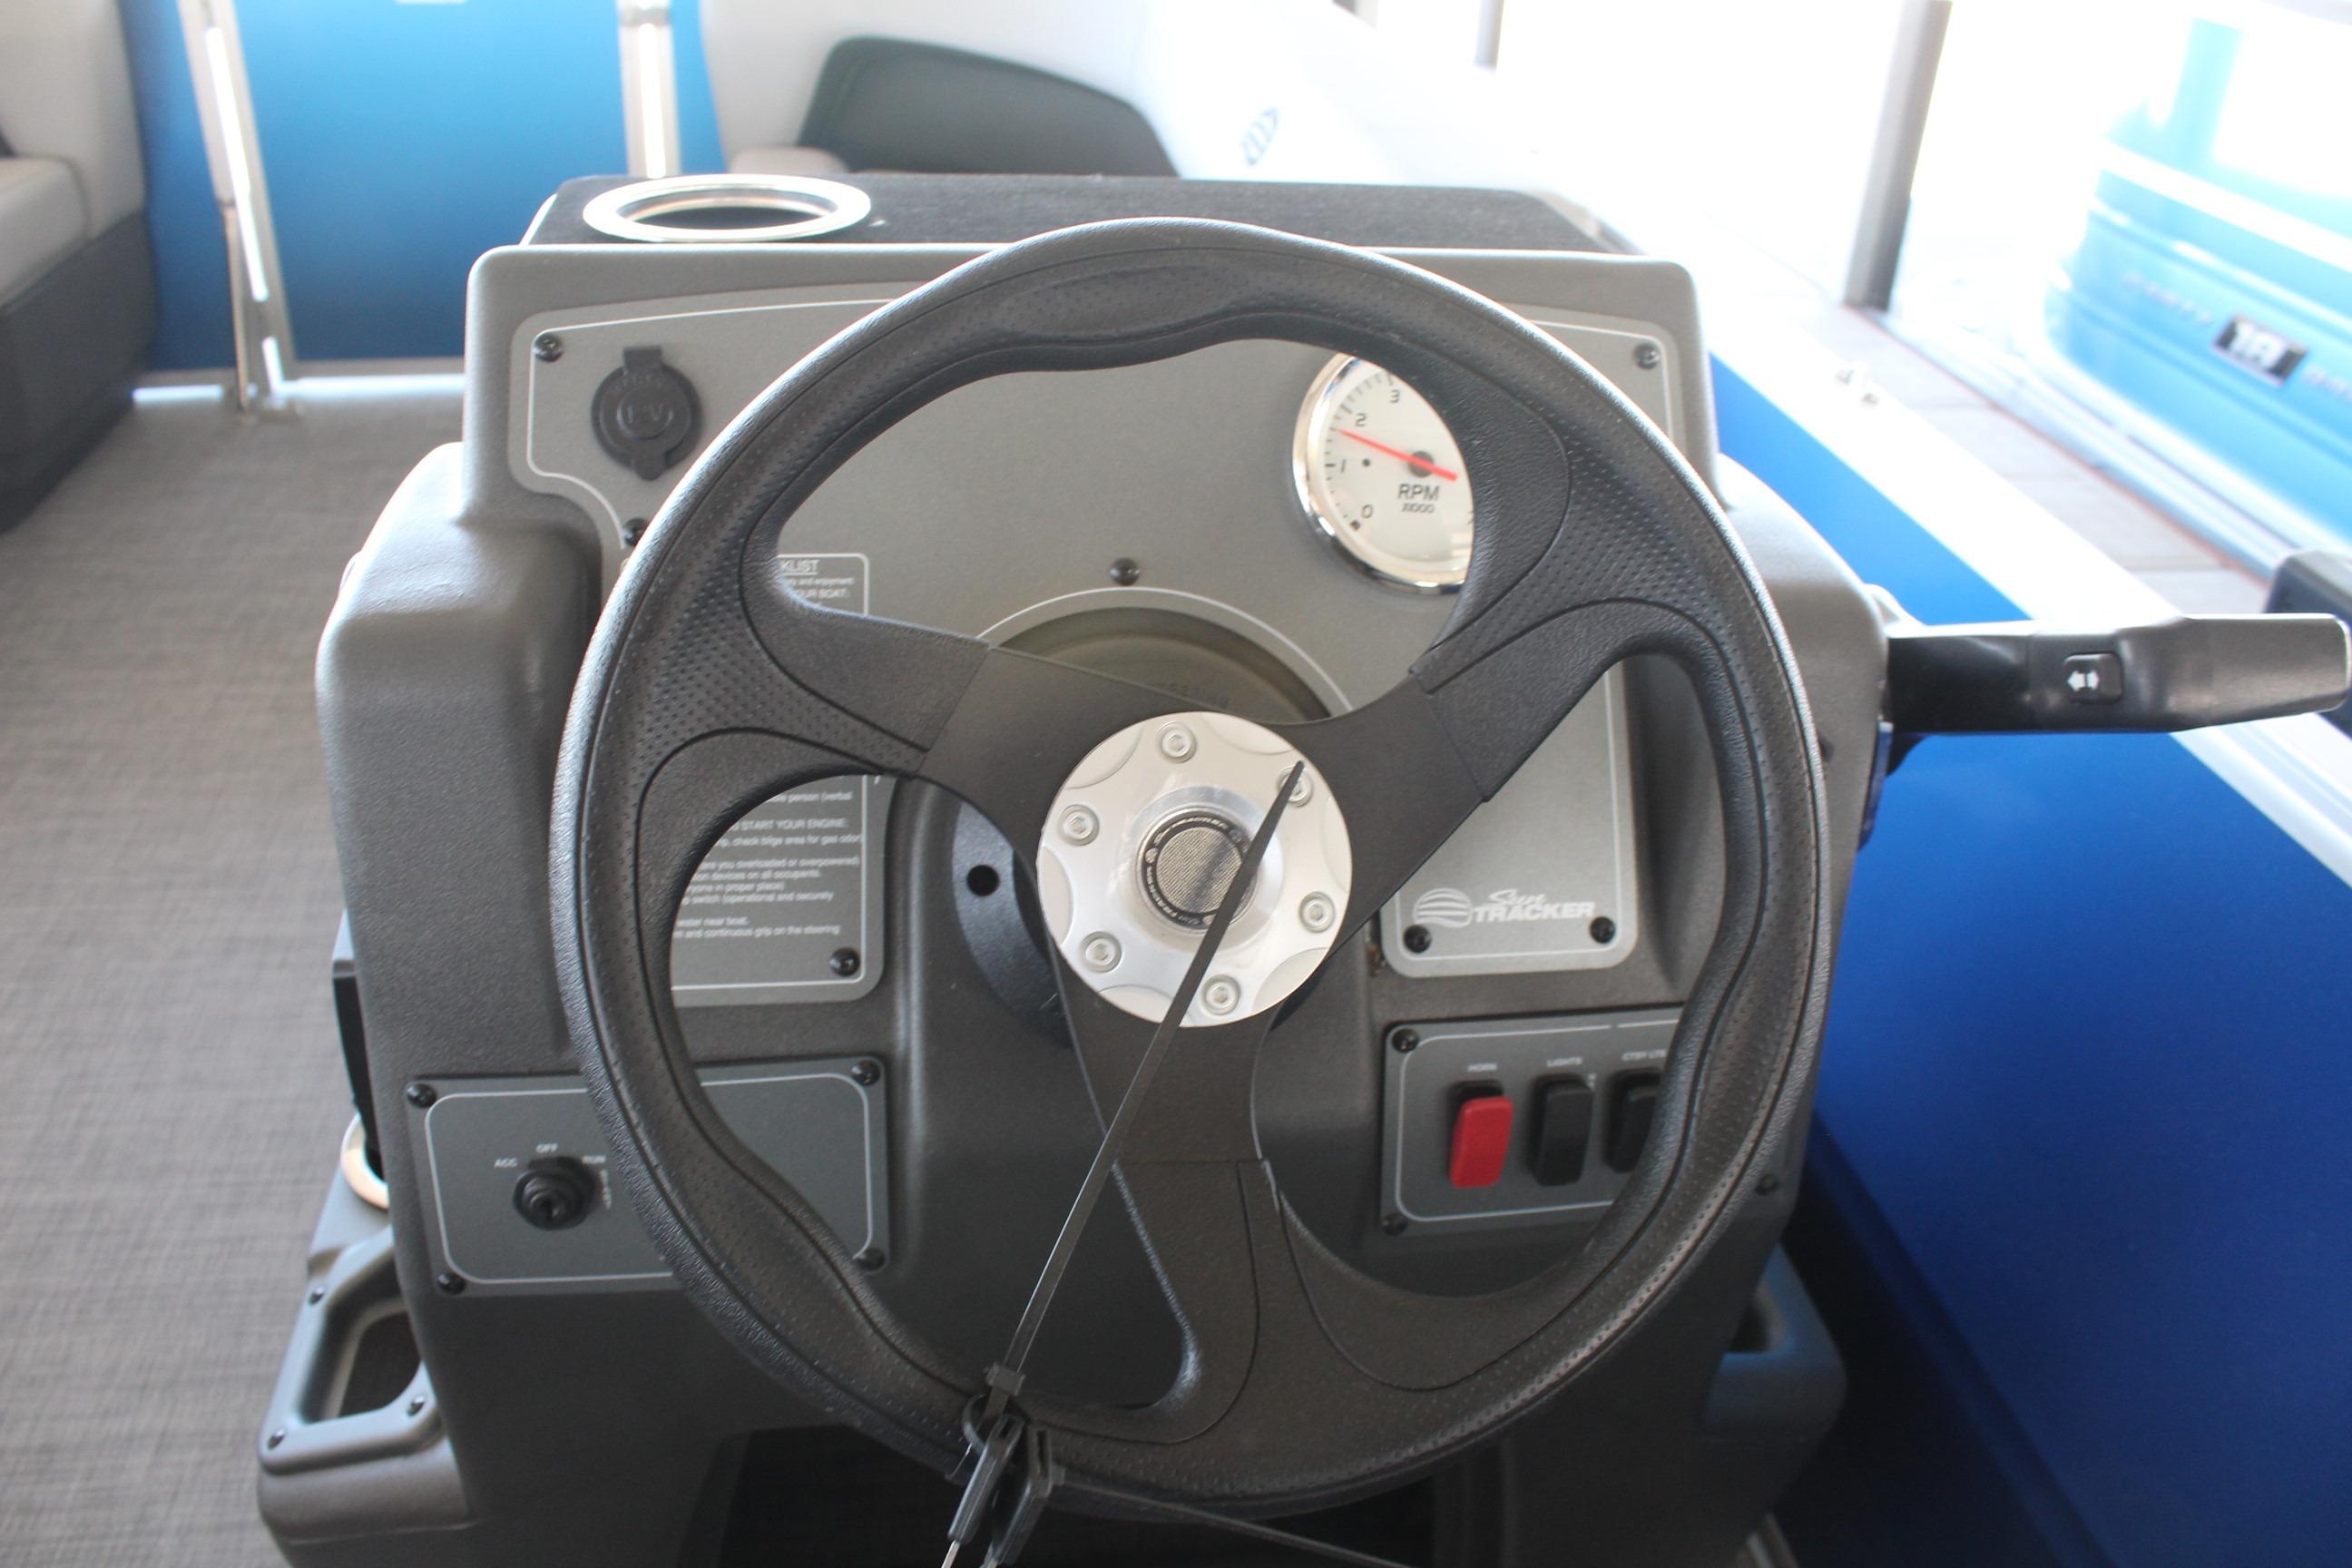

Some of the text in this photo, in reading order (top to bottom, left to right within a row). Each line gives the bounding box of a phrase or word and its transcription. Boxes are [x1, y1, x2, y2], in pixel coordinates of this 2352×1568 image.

[1389, 388, 1401, 404] 3
[1355, 413, 1367, 427] 2
[1397, 484, 1440, 500] RPM
[1361, 505, 1373, 519] 0
[740, 819, 774, 830] START
[776, 818, 806, 829] YOUR
[732, 837, 759, 847] check
[760, 836, 783, 848] bilge
[807, 835, 818, 844] for
[820, 836, 838, 847] gas
[718, 861, 735, 872] you
[736, 858, 786, 868] overloaded
[777, 892, 794, 901] and
[1472, 901, 1596, 923] TRACKER
[685, 928, 702, 938] and
[704, 927, 753, 937] continuous
[755, 926, 772, 938] grip
[773, 927, 786, 936] on
[788, 925, 802, 935] the
[803, 924, 841, 936] steering
[1467, 1063, 1498, 1073] HORN
[1546, 1056, 1583, 1068] LIGHTS
[535, 1143, 559, 1153] OFF
[494, 1157, 518, 1168] ACC
